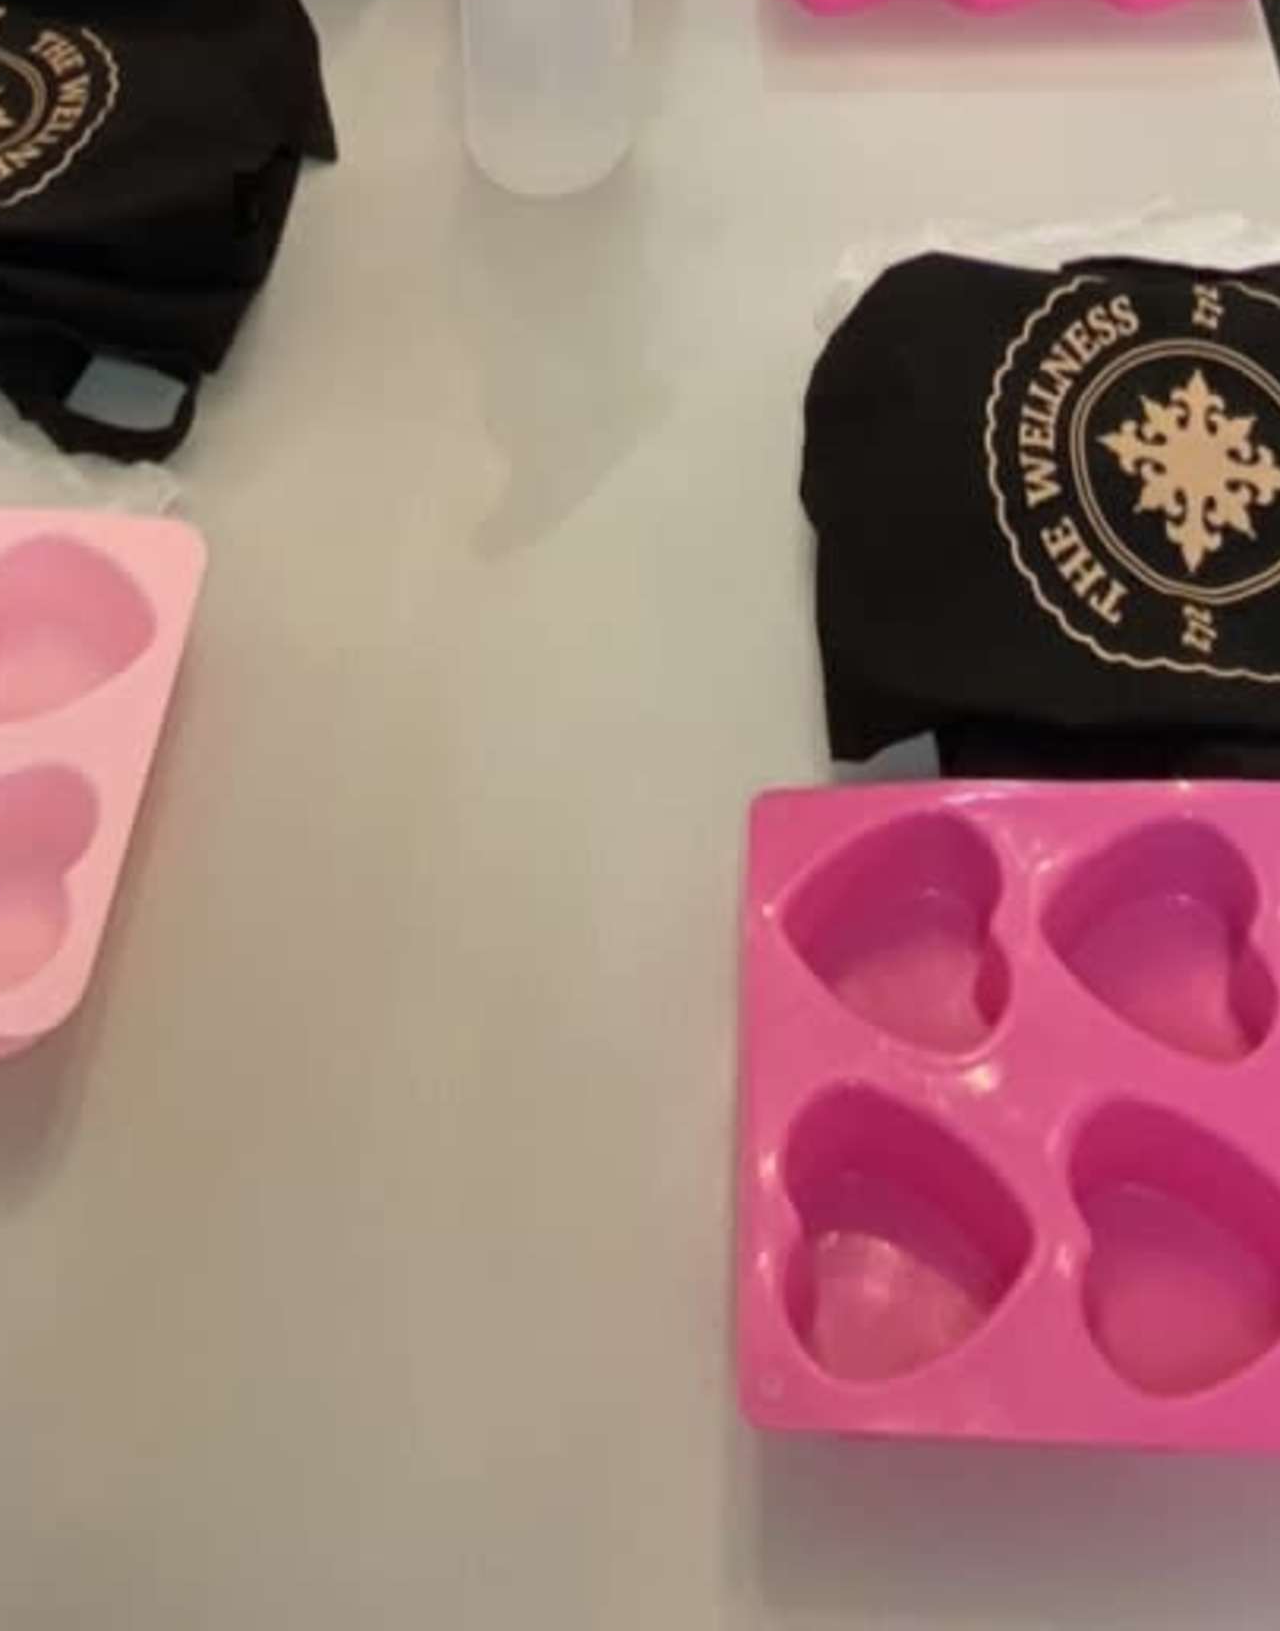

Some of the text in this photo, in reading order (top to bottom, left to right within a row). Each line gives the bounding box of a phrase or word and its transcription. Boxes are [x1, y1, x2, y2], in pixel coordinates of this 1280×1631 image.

[31, 30, 85, 81] THE
[1020, 295, 1141, 625] THE WELLNESS
